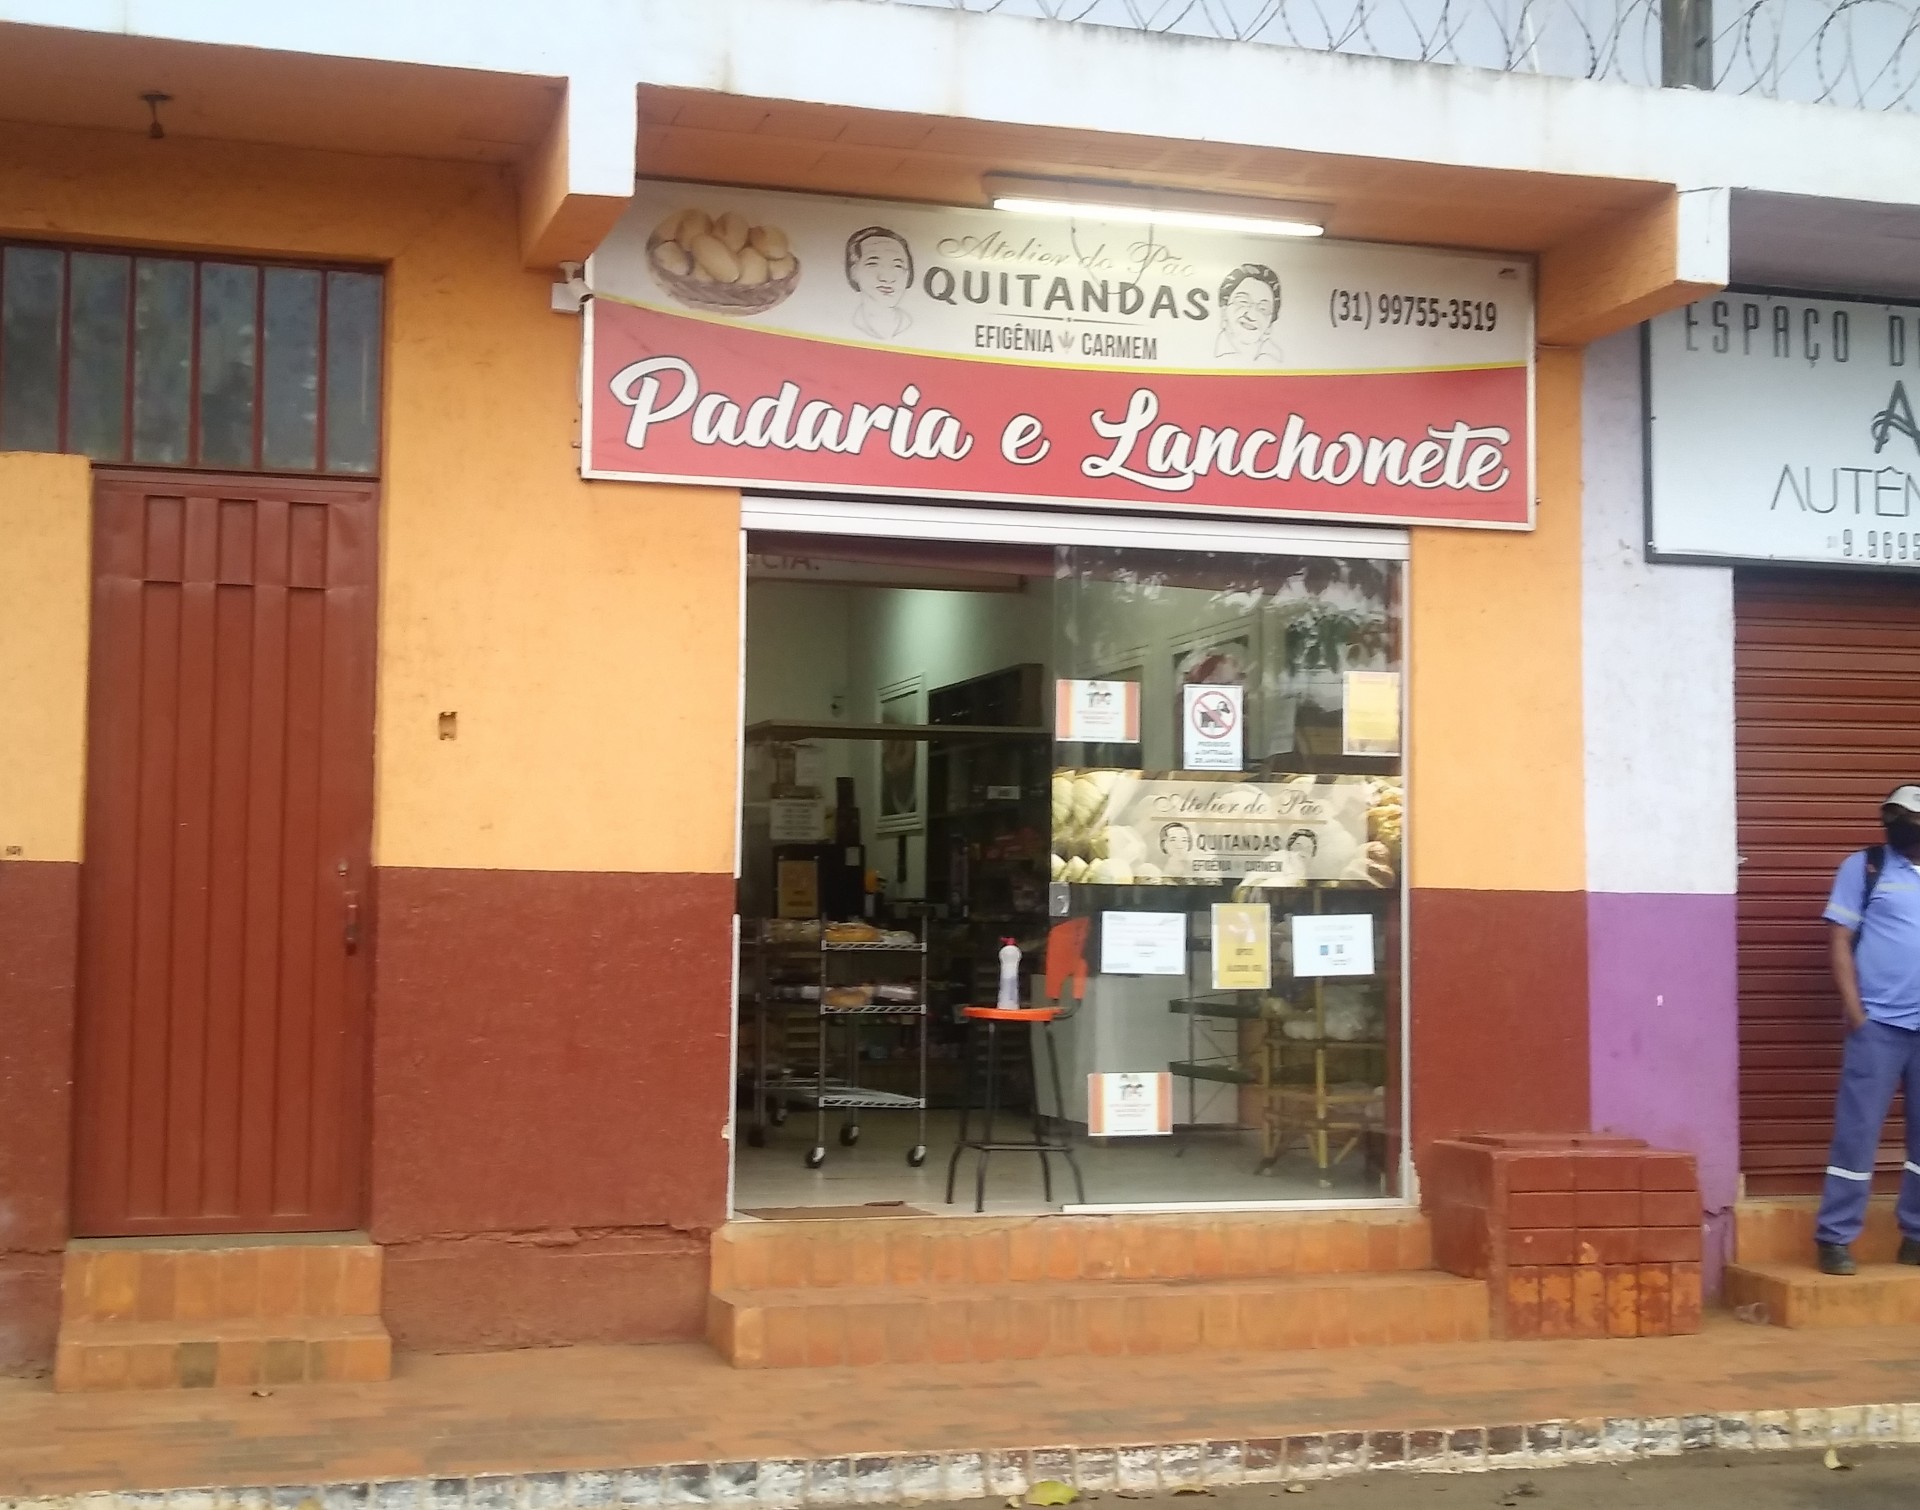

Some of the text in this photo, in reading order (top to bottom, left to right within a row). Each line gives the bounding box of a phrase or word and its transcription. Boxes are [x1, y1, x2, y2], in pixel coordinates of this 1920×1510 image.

[936, 230, 1195, 278] Atelier do Pão
[923, 266, 1210, 321] QUITANDAS
[1330, 288, 1497, 332] (31) 99755-3519
[974, 323, 1157, 360] EFIGÊNIA CARMEM
[1685, 300, 1920, 368] ESPAÇO D
[610, 356, 1512, 492] Padaria e Lanchonete
[1153, 789, 1240, 814] Atelier
[1197, 833, 1282, 852] QUITANDAS
